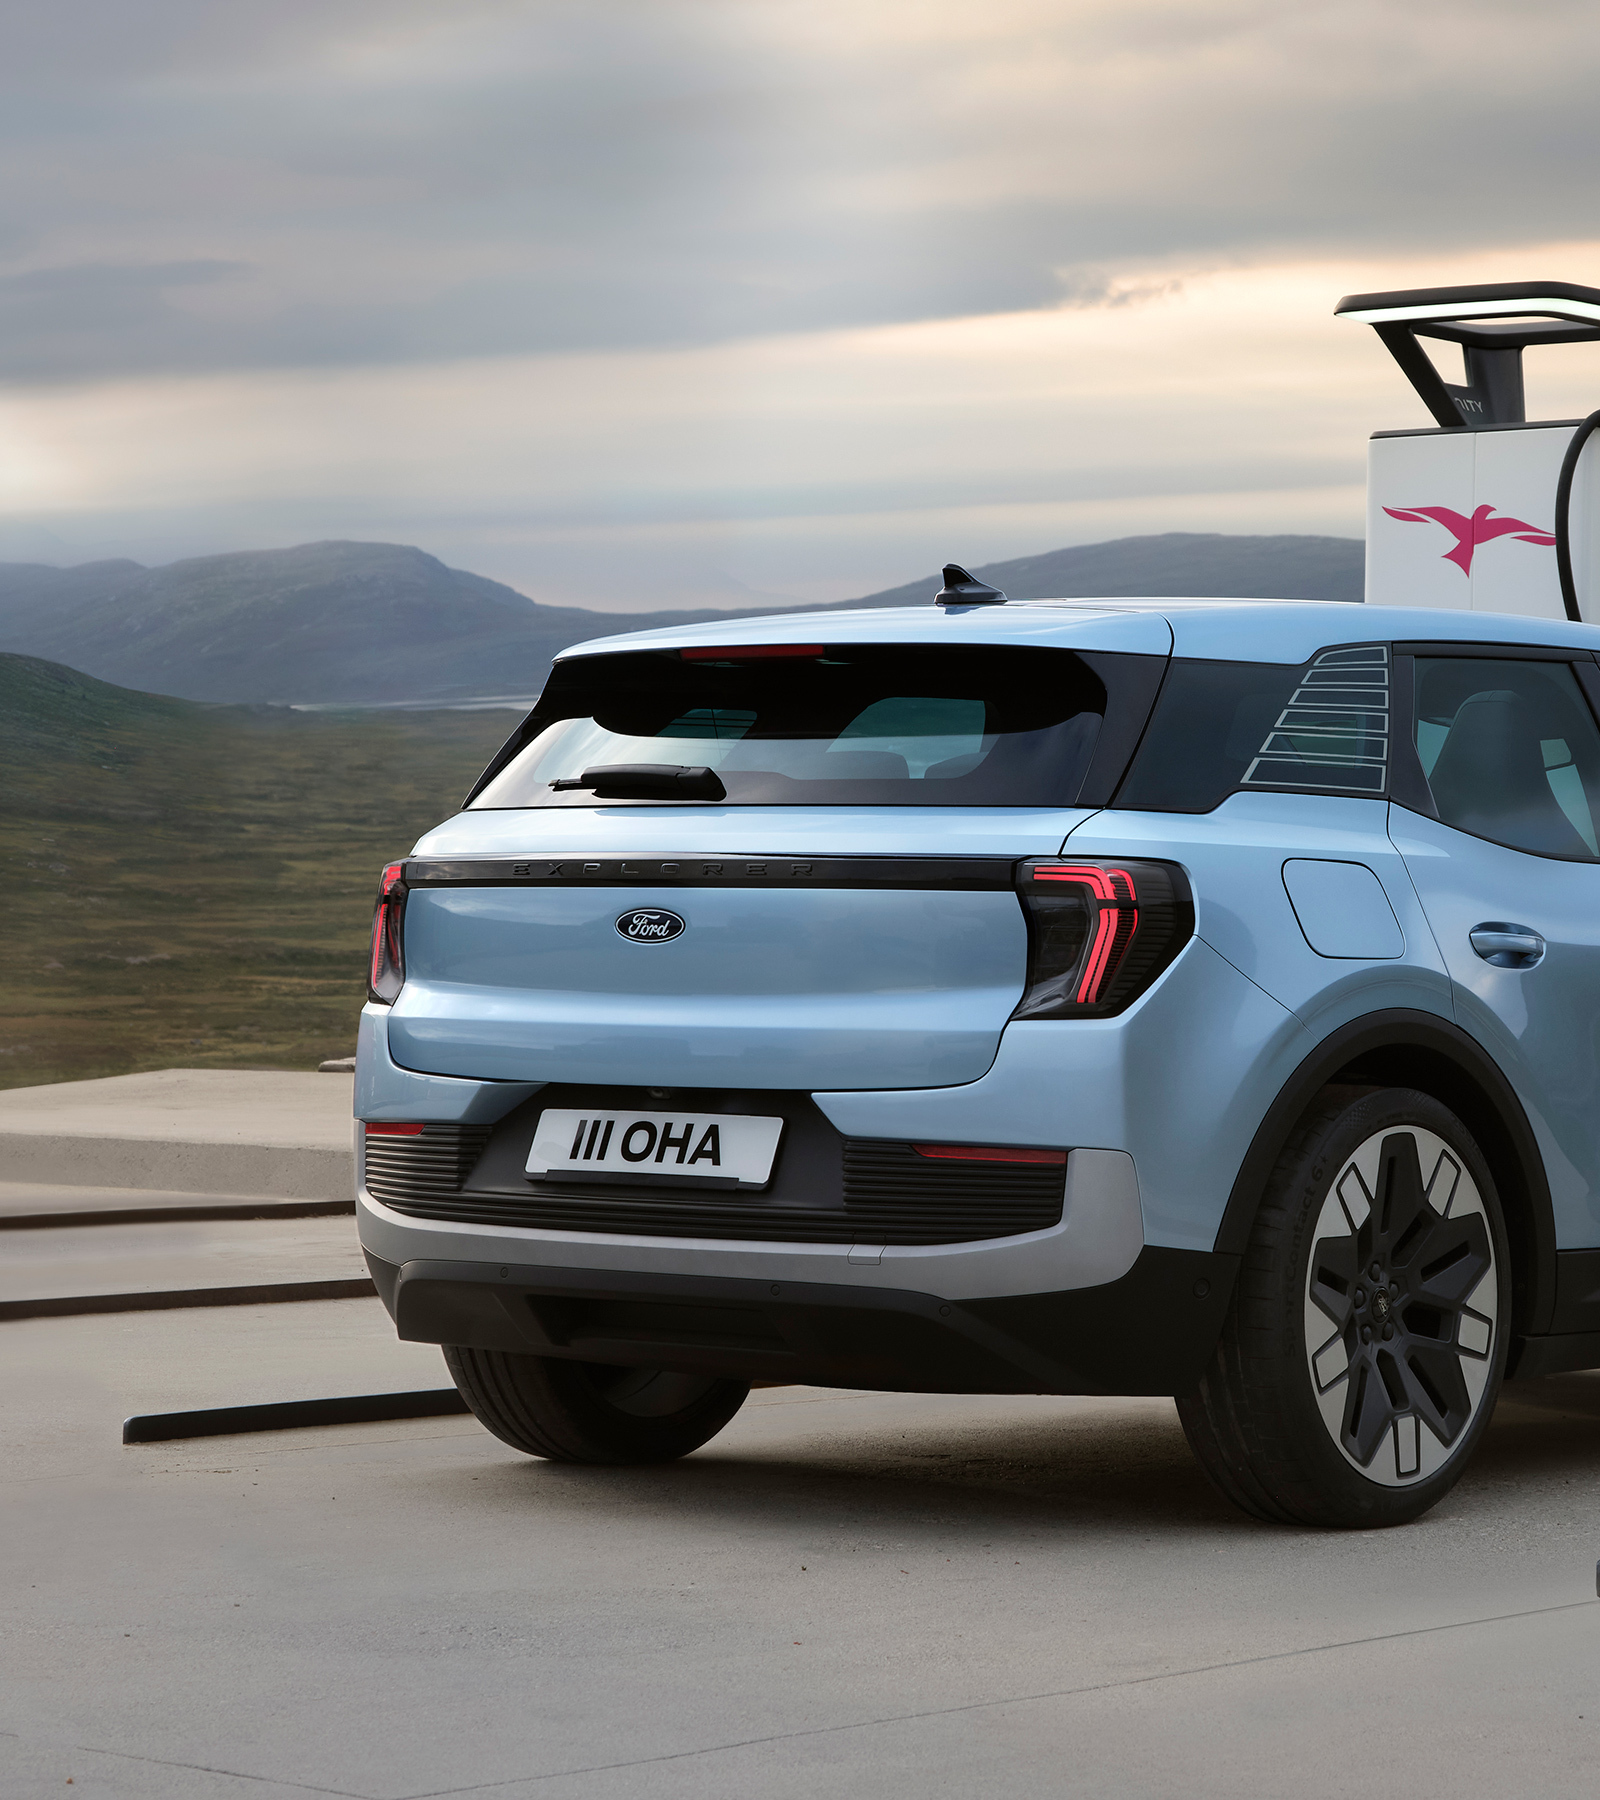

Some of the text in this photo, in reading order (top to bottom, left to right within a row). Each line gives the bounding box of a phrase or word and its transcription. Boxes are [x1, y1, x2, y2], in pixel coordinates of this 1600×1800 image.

[511, 862, 814, 877] EXPLORER
[627, 912, 672, 937] Ford
[620, 1120, 721, 1167] OHA
[1311, 1165, 1324, 1182] 6
